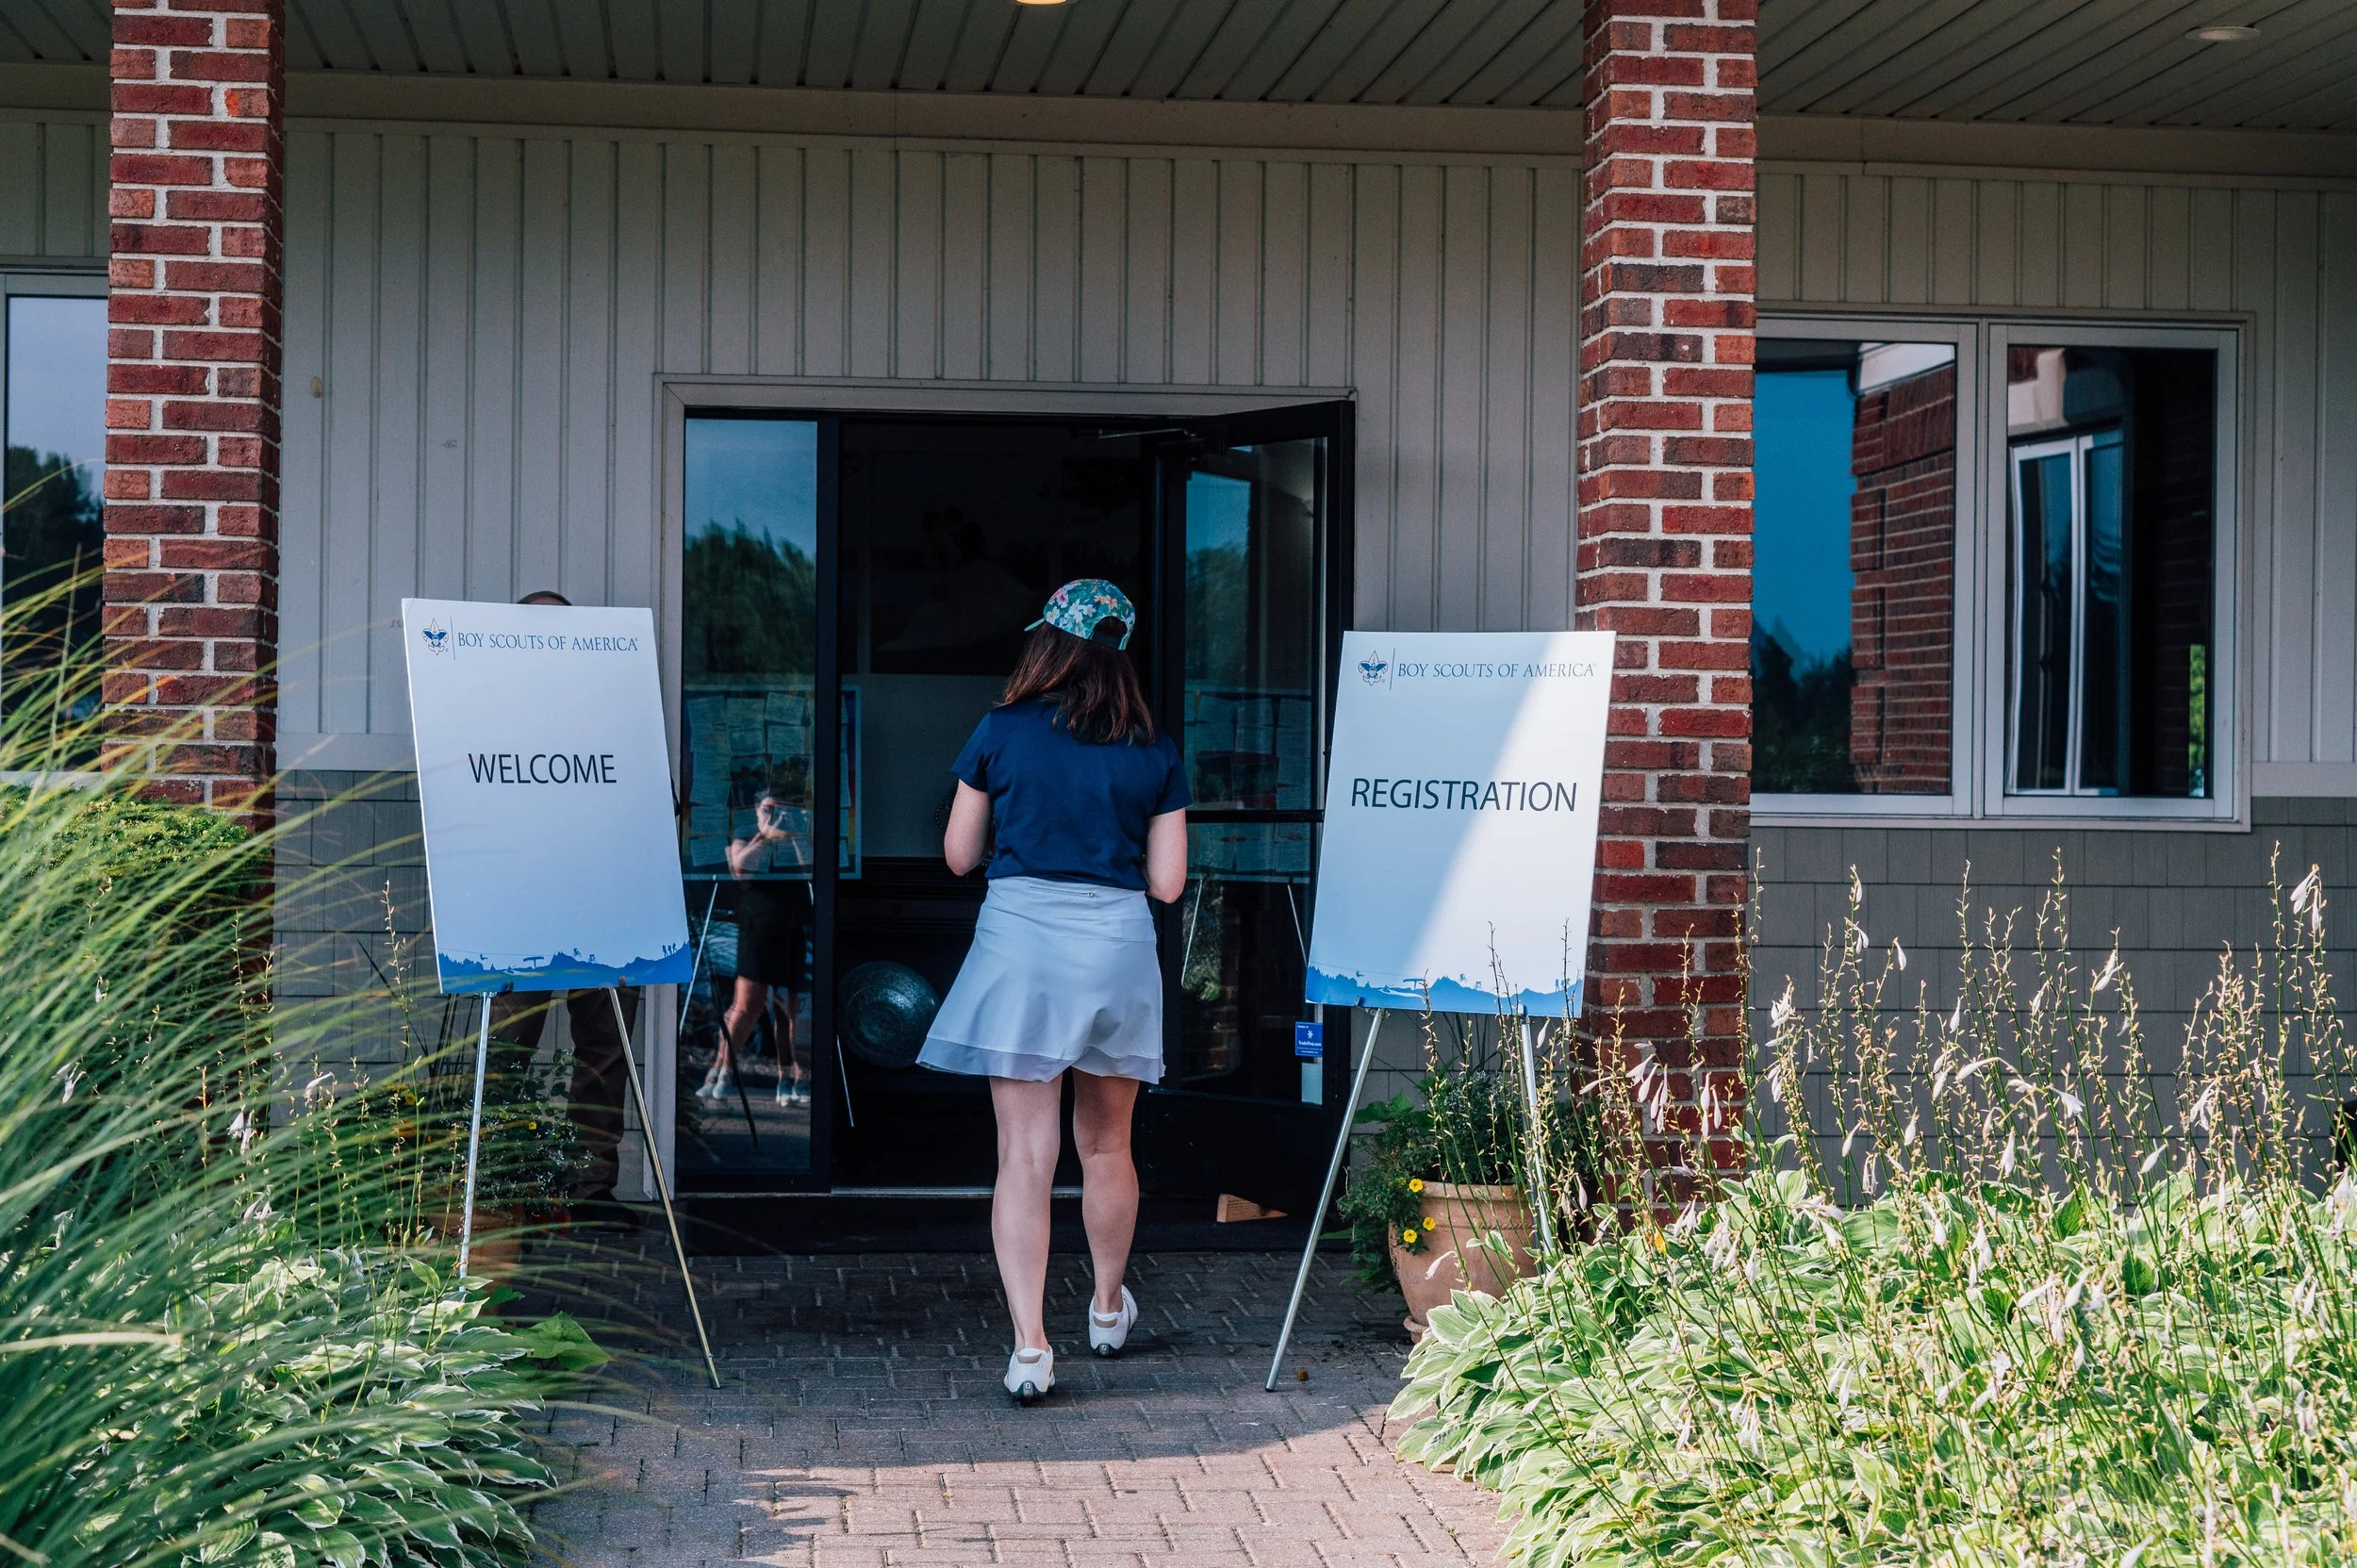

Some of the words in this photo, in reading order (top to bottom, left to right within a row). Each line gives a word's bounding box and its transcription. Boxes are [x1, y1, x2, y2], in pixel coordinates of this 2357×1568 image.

[458, 633, 485, 648] BOY
[489, 634, 544, 650] SCOUTS
[548, 635, 567, 651] OF
[571, 637, 638, 652] AMERICA
[1397, 663, 1429, 677] BOY
[1432, 663, 1493, 678] SCOUTS
[1497, 663, 1520, 678] OF
[1523, 663, 1595, 678] AMERICA
[468, 752, 618, 784] WELCOME
[1351, 778, 1577, 812] REGISTRATION
